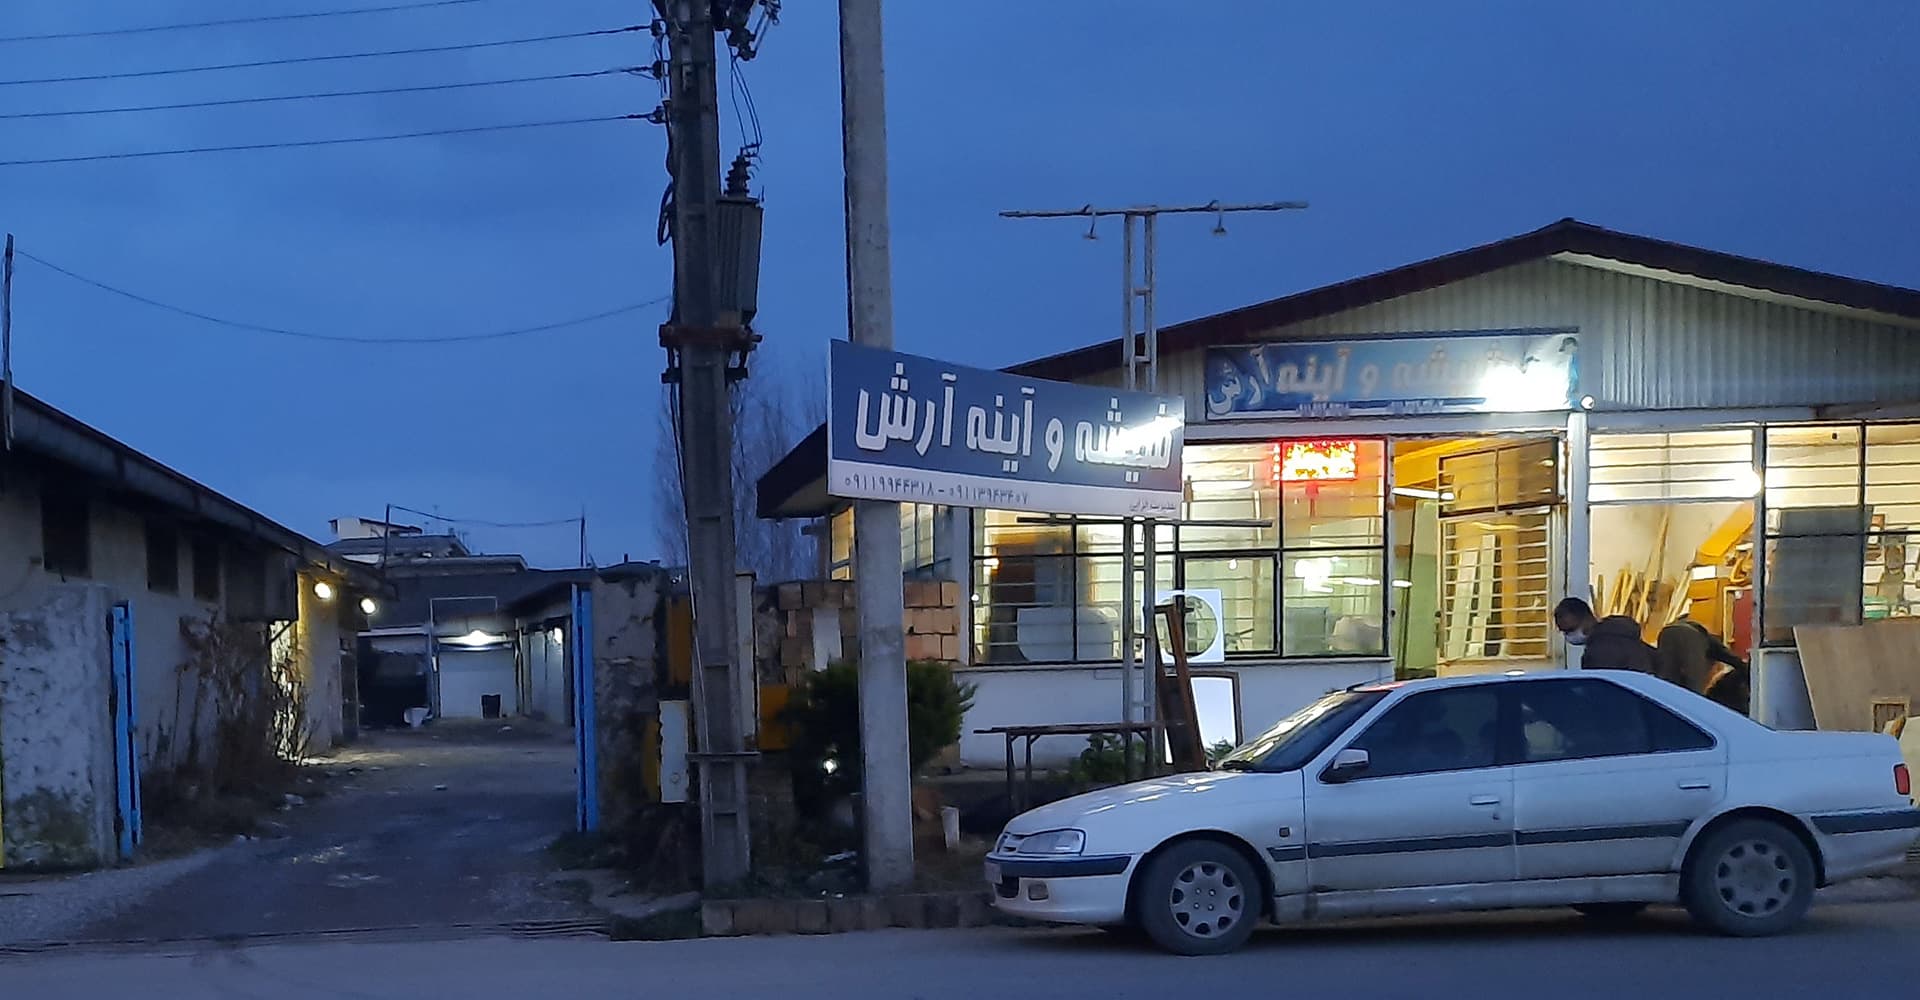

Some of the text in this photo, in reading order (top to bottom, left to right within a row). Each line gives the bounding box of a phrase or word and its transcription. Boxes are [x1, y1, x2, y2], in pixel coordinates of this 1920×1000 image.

[1208, 345, 1270, 416] آرش
[1276, 348, 1351, 402] آینه
[1360, 363, 1379, 399] و
[855, 362, 1173, 483] شیشه و آینه آرش
